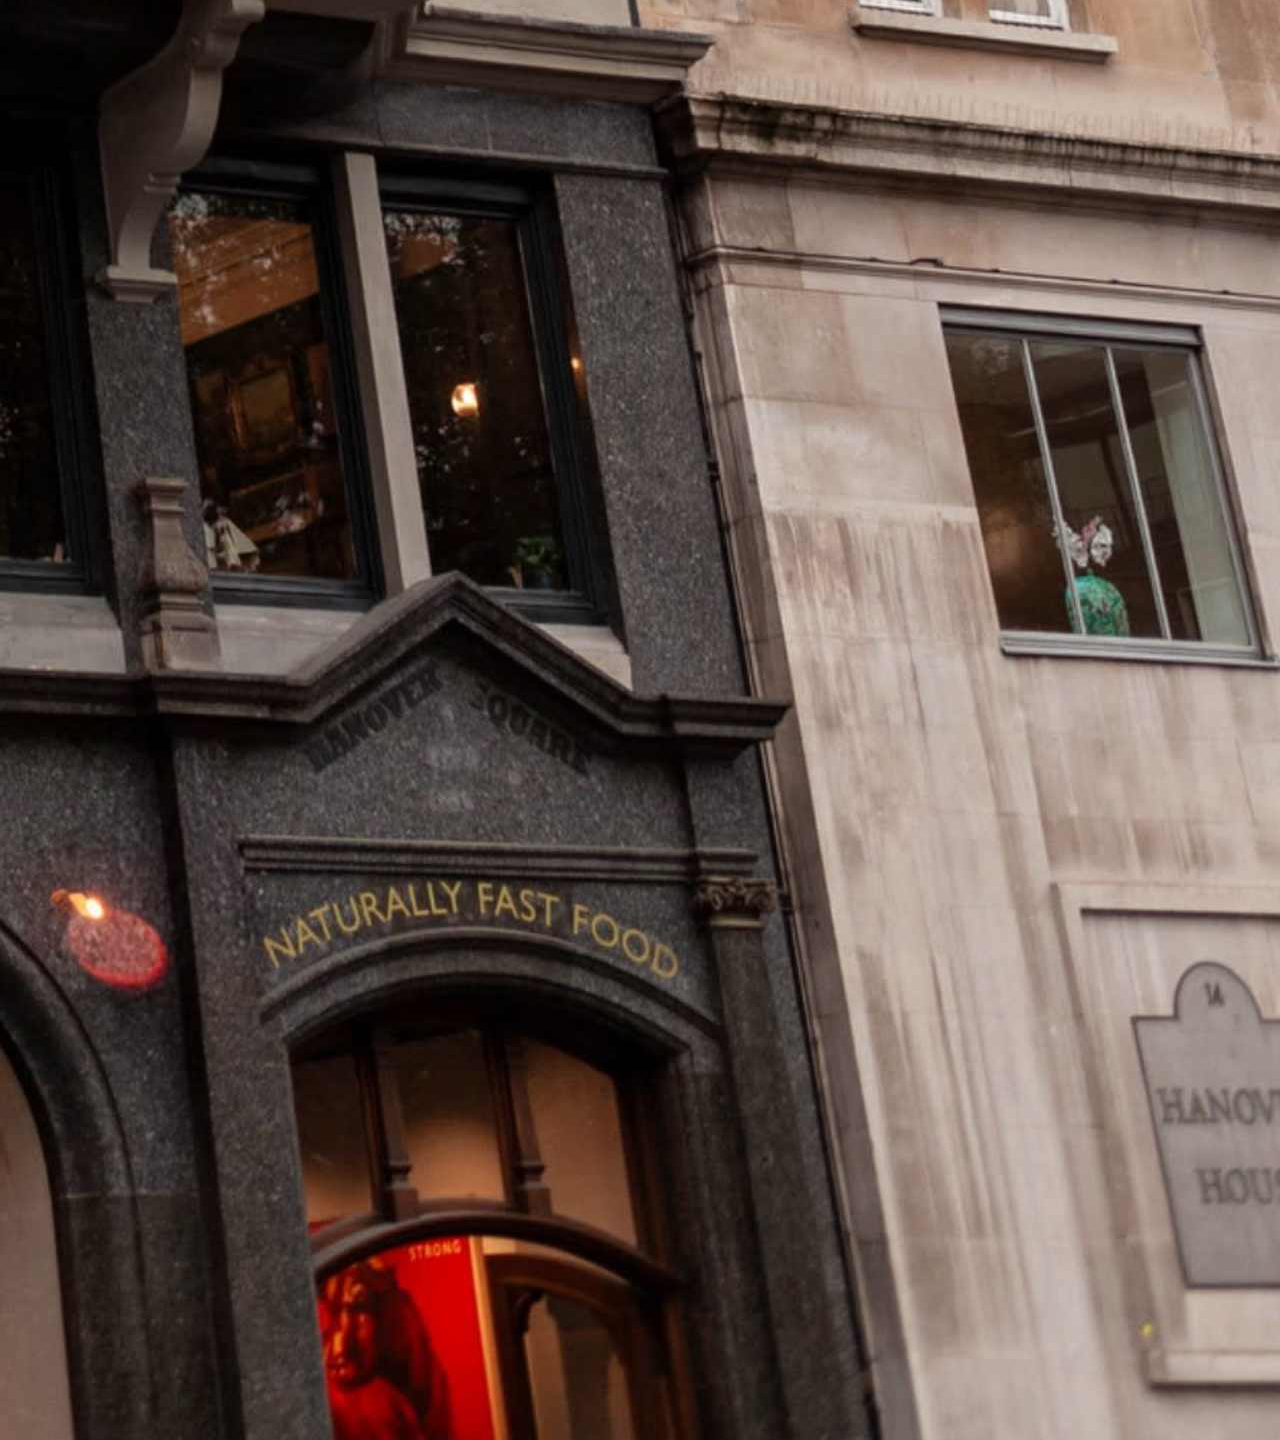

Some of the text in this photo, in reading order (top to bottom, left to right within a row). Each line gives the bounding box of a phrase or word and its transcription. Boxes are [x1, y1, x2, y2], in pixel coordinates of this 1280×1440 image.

[302, 658, 443, 771] HANOVER
[262, 881, 680, 980] NATURALLY FAST FOOD
[1156, 1087, 1280, 1126] HANOV
[407, 1238, 462, 1262] STRONG
